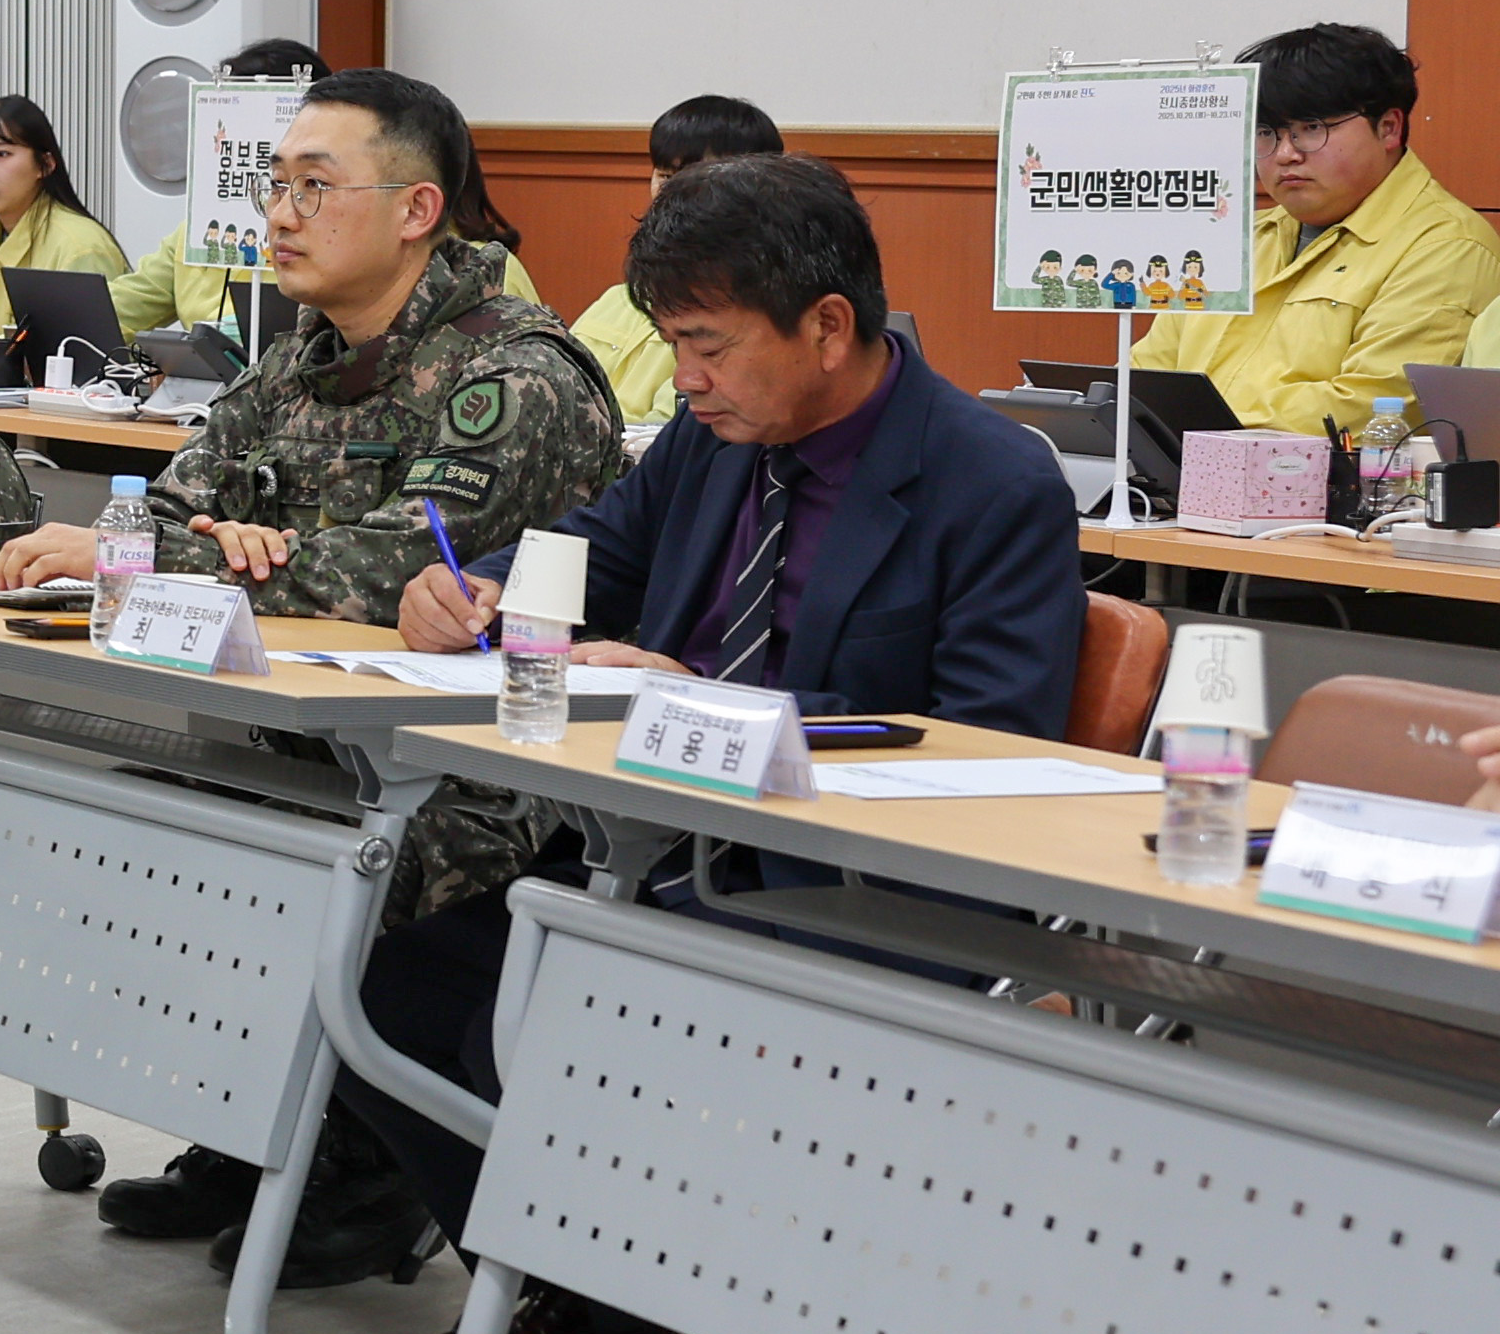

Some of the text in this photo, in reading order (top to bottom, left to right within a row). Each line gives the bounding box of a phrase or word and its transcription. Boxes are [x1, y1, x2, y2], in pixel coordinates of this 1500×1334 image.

[1159, 84, 1186, 94] 2025년
[1159, 95, 1229, 109] 전시종합상황실
[1029, 168, 1219, 209] 군민생활안정반
[445, 465, 491, 488] 경계부대
[452, 487, 480, 501] FORCES
[127, 596, 226, 626] 한국농어촌공사 진도지사장
[132, 617, 202, 653] 최 진
